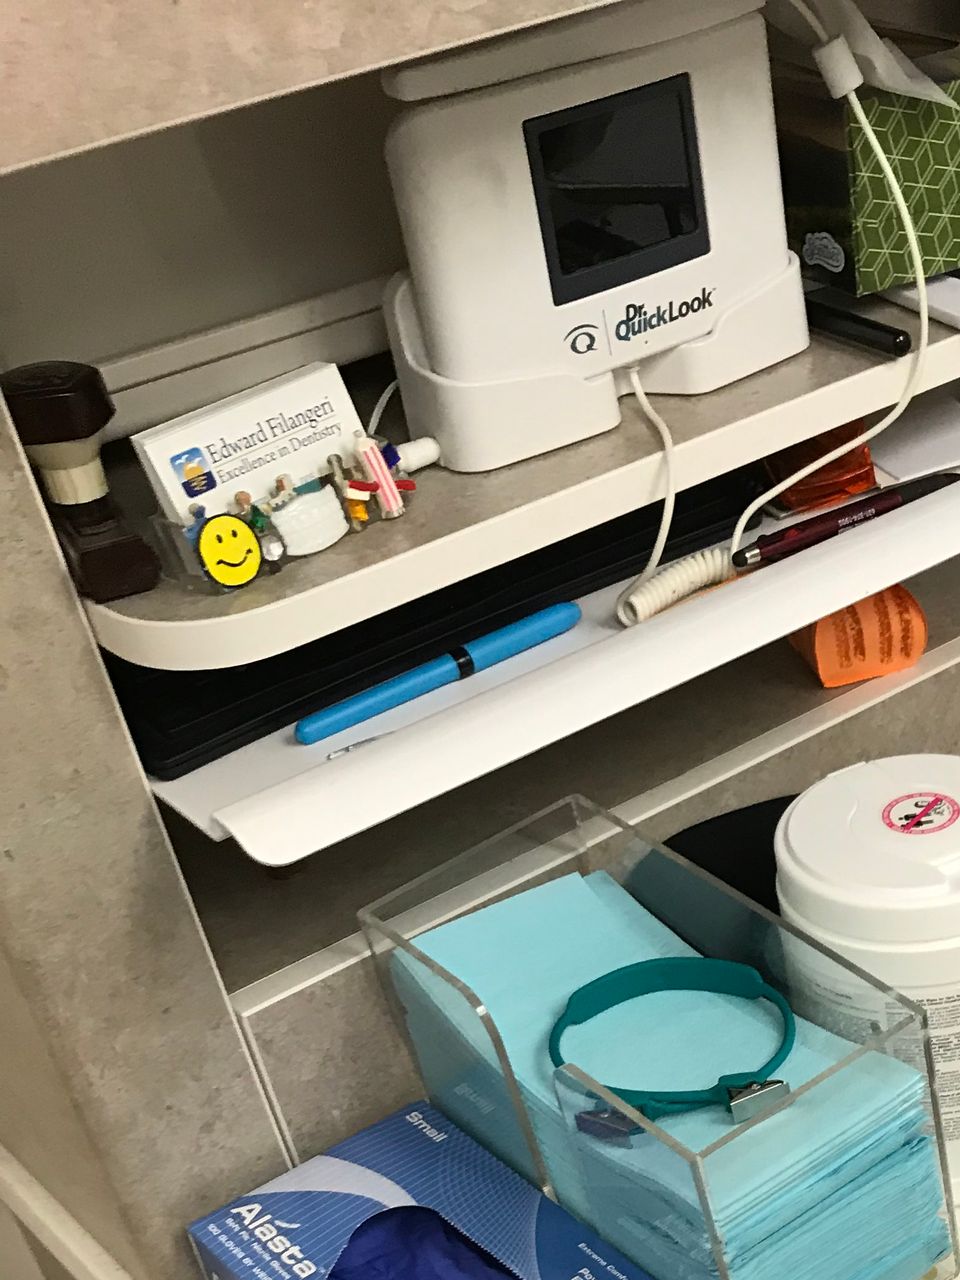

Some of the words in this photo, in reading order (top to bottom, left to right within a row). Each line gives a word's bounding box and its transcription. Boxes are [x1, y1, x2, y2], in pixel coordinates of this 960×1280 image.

[625, 303, 648, 322] Dr.
[205, 421, 269, 464] Edward
[265, 396, 336, 438] Filangeri
[215, 450, 278, 485] Excellence
[278, 443, 291, 459] in
[287, 421, 343, 452] Dentistry
[405, 1111, 449, 1142] Small
[218, 1234, 246, 1259] GLOVES
[577, 1242, 607, 1267] Extreme
